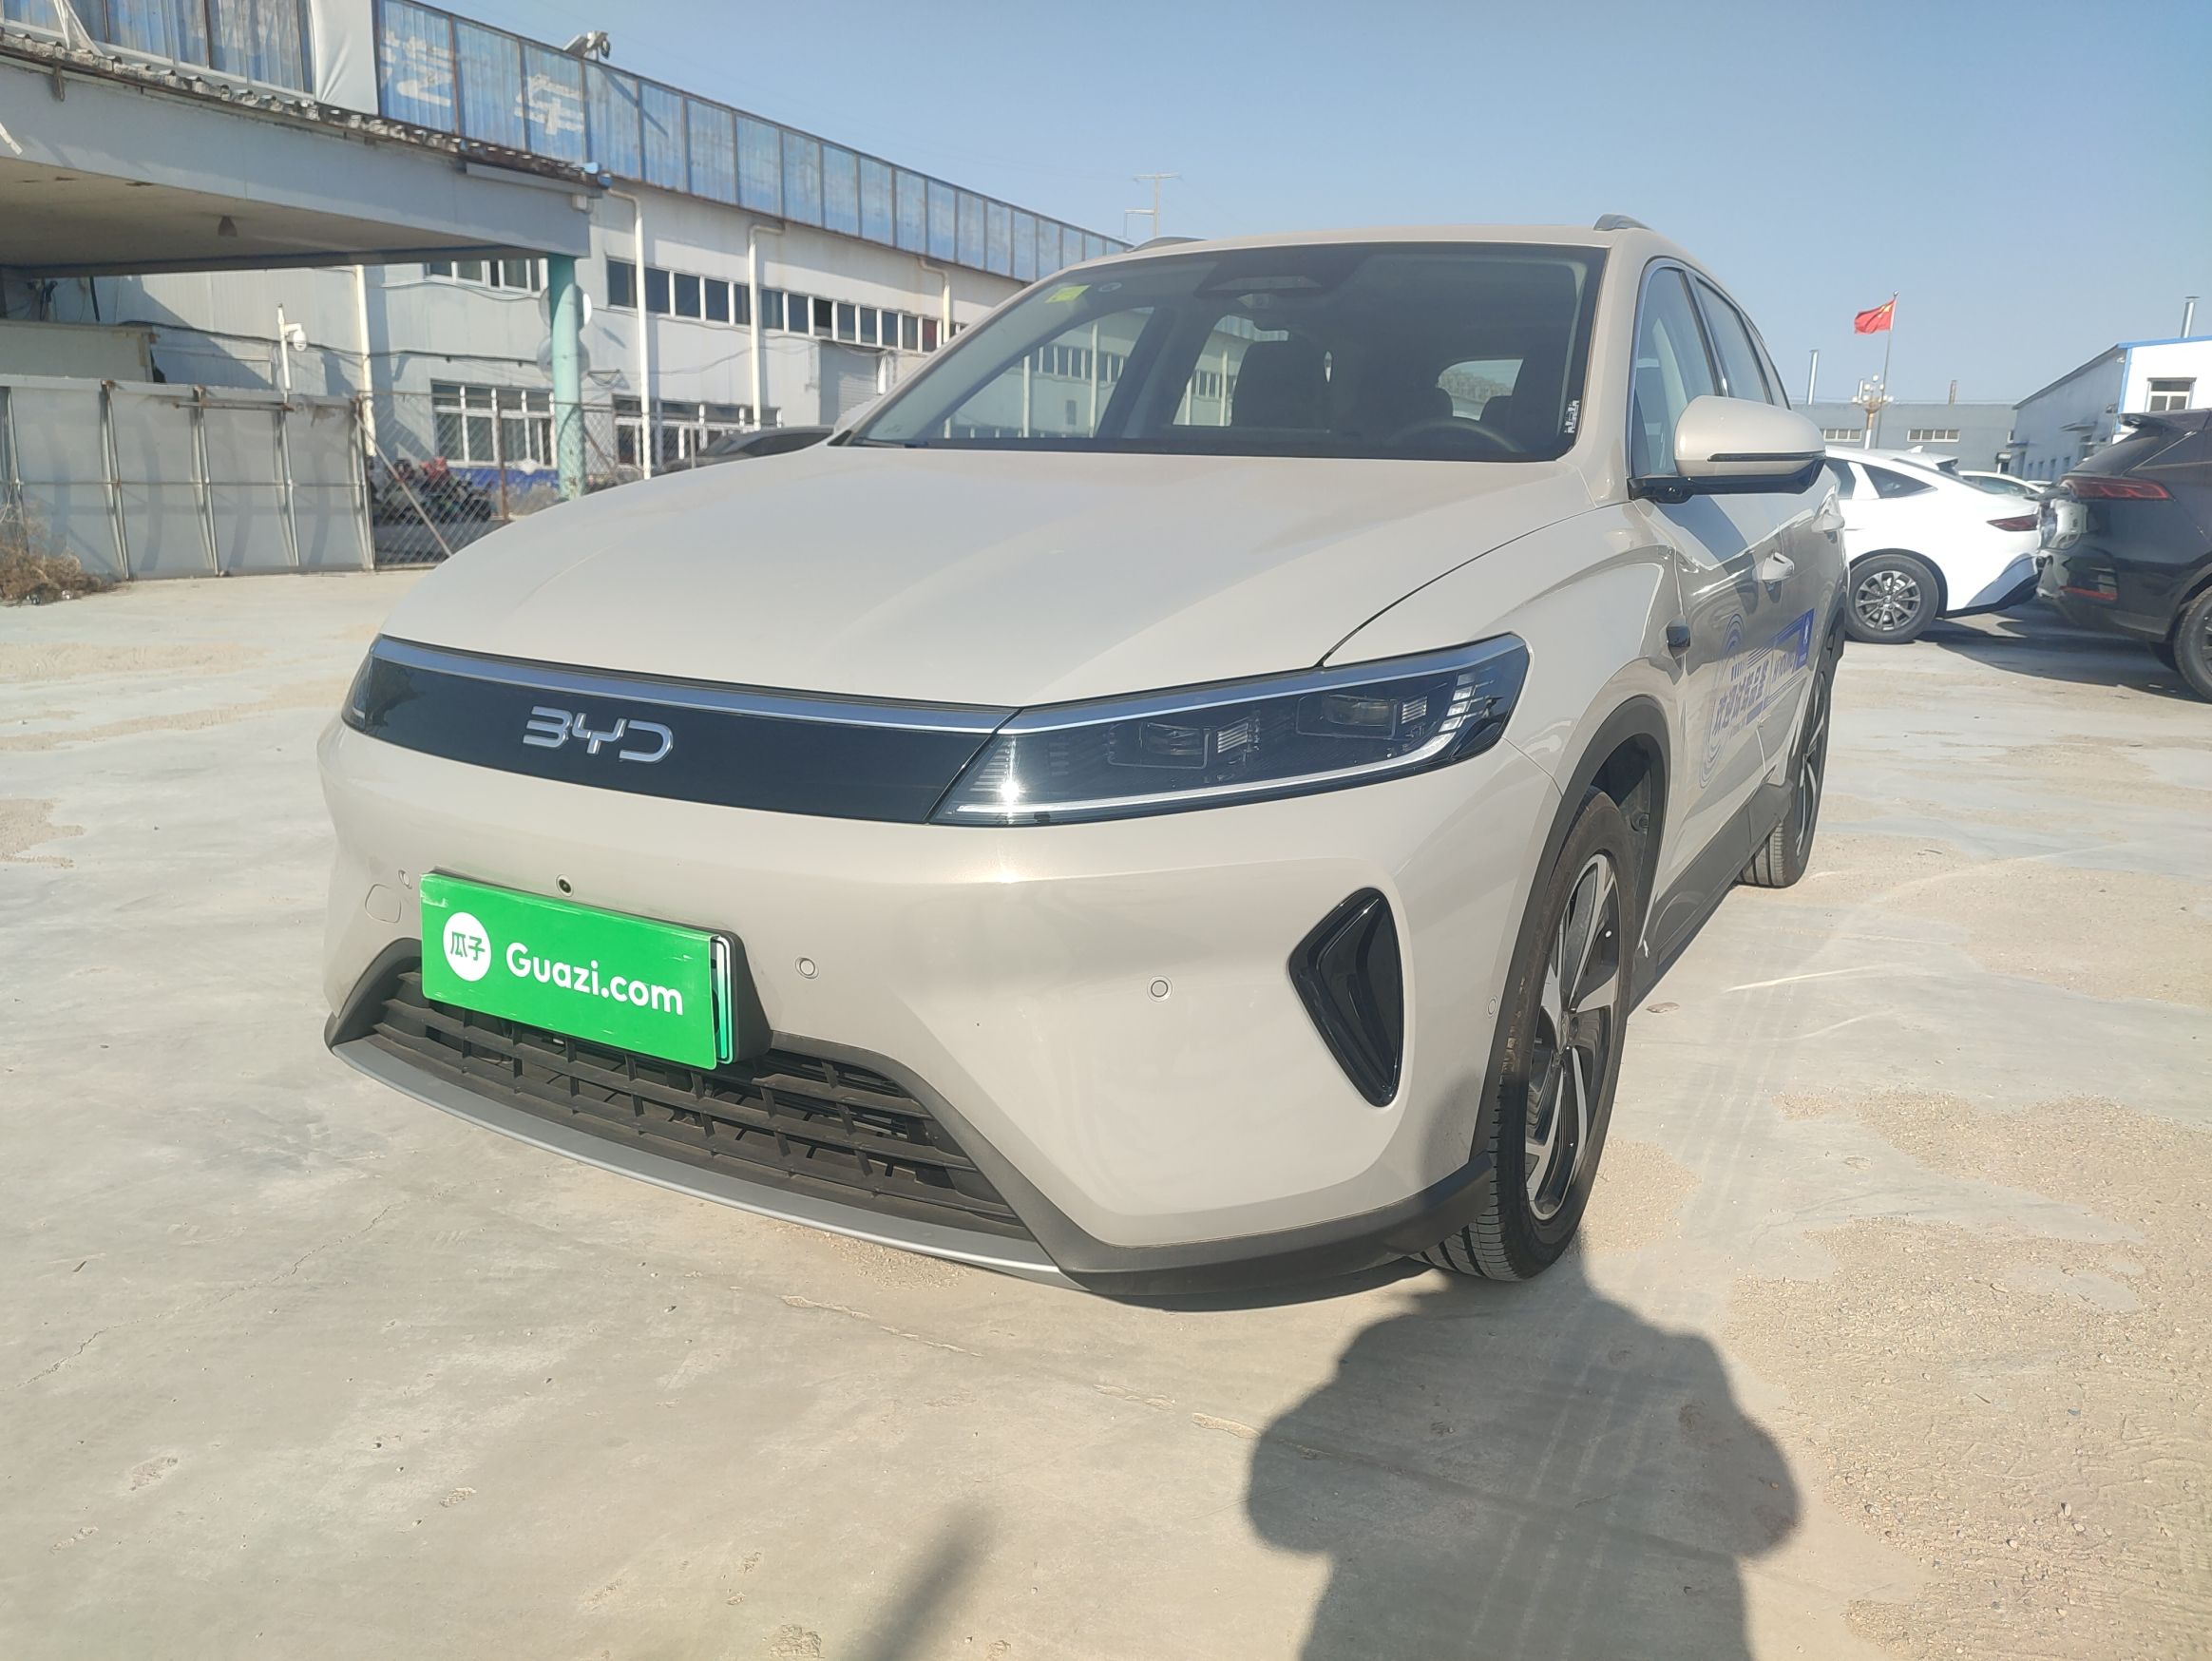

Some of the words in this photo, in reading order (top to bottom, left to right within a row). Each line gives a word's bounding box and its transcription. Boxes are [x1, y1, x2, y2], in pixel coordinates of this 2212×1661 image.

[523, 706, 674, 764] BYD
[450, 930, 486, 961] 瓜子
[506, 942, 683, 1016] Guazi.com
